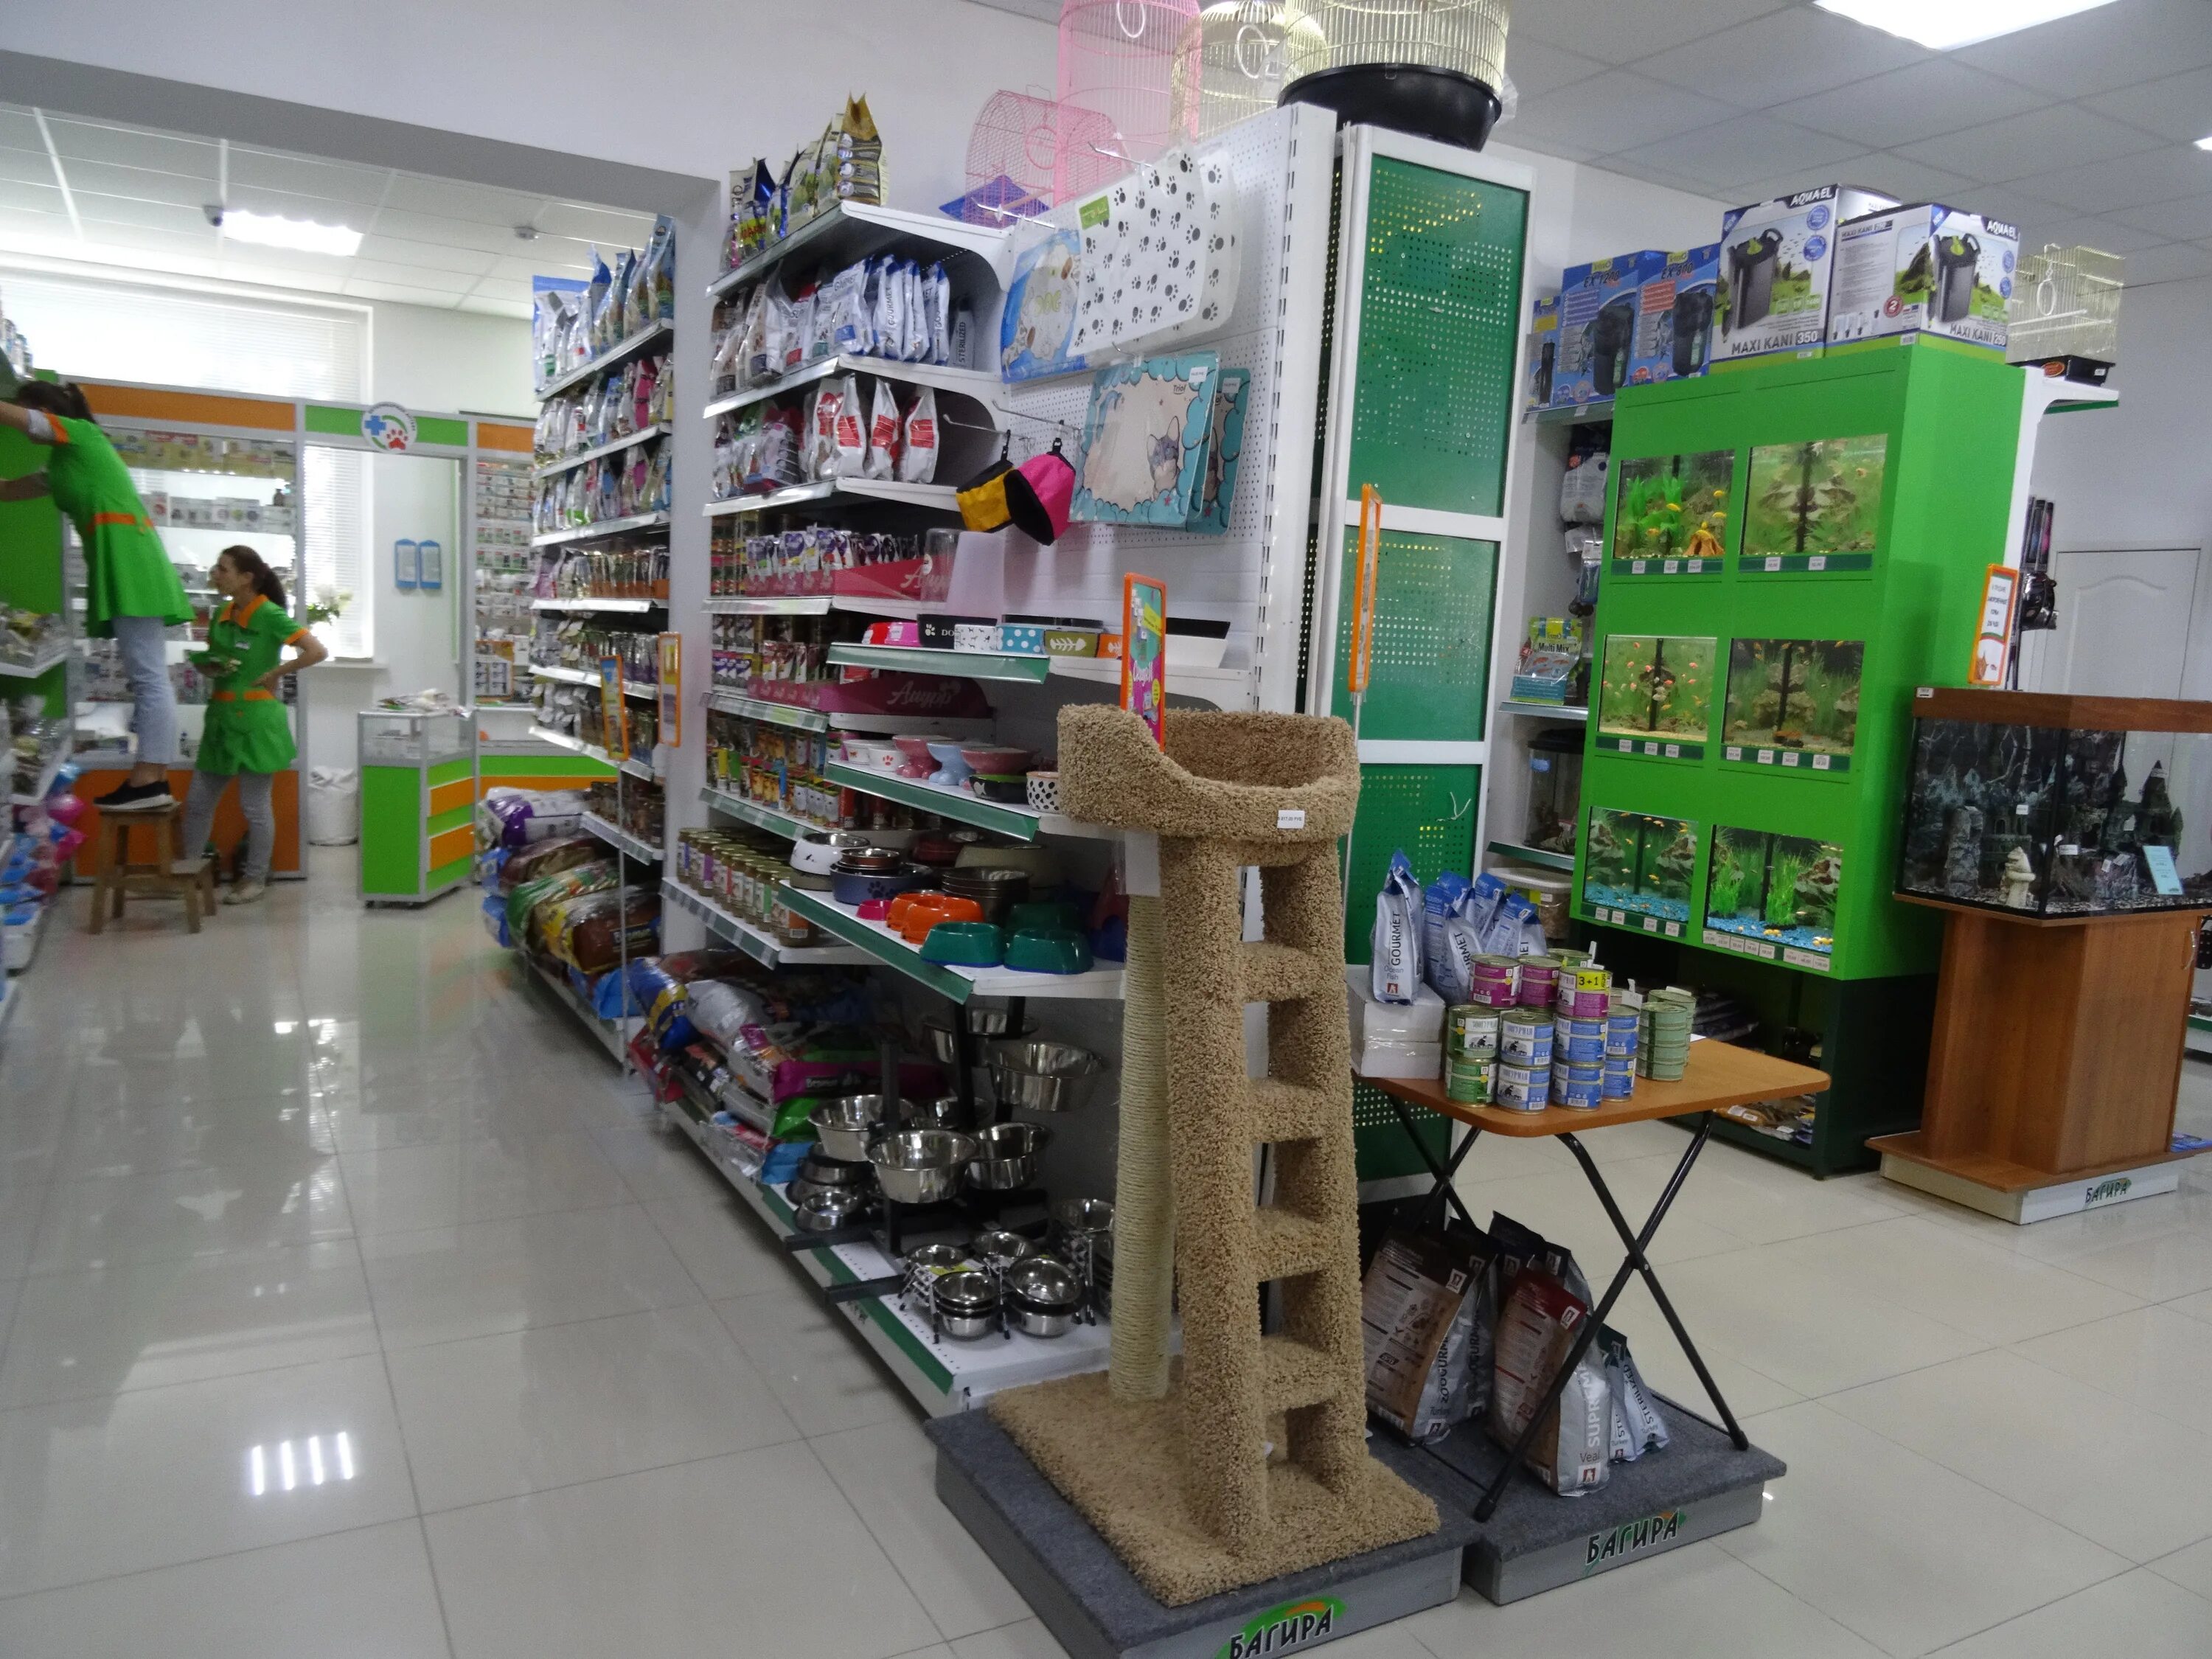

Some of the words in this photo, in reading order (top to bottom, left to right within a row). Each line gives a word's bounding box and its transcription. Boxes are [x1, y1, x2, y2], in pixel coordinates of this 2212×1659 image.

[1790, 187, 1832, 206] AQUAEL
[1986, 220, 2017, 240] AQUAEL
[1731, 339, 1761, 355] MAXI
[1764, 333, 1793, 350] KANI
[1797, 331, 1818, 345] 350
[1950, 324, 1970, 338] MAXI
[1972, 328, 1992, 343] KANI
[1539, 642, 1555, 652] Multi
[1557, 644, 1569, 653] Mix
[1391, 911, 1401, 966] GOURMET
[2085, 1180, 2129, 1203] БАГИРА
[1438, 1337, 1450, 1404] ZOOGURM
[1578, 1362, 1601, 1447] SUPRME
[1624, 1364, 1654, 1425] STERILIZED
[1580, 1452, 1600, 1463] Veal
[1586, 1508, 1680, 1565] БАГИРА
[1230, 1604, 1333, 1659] БАГИРА
